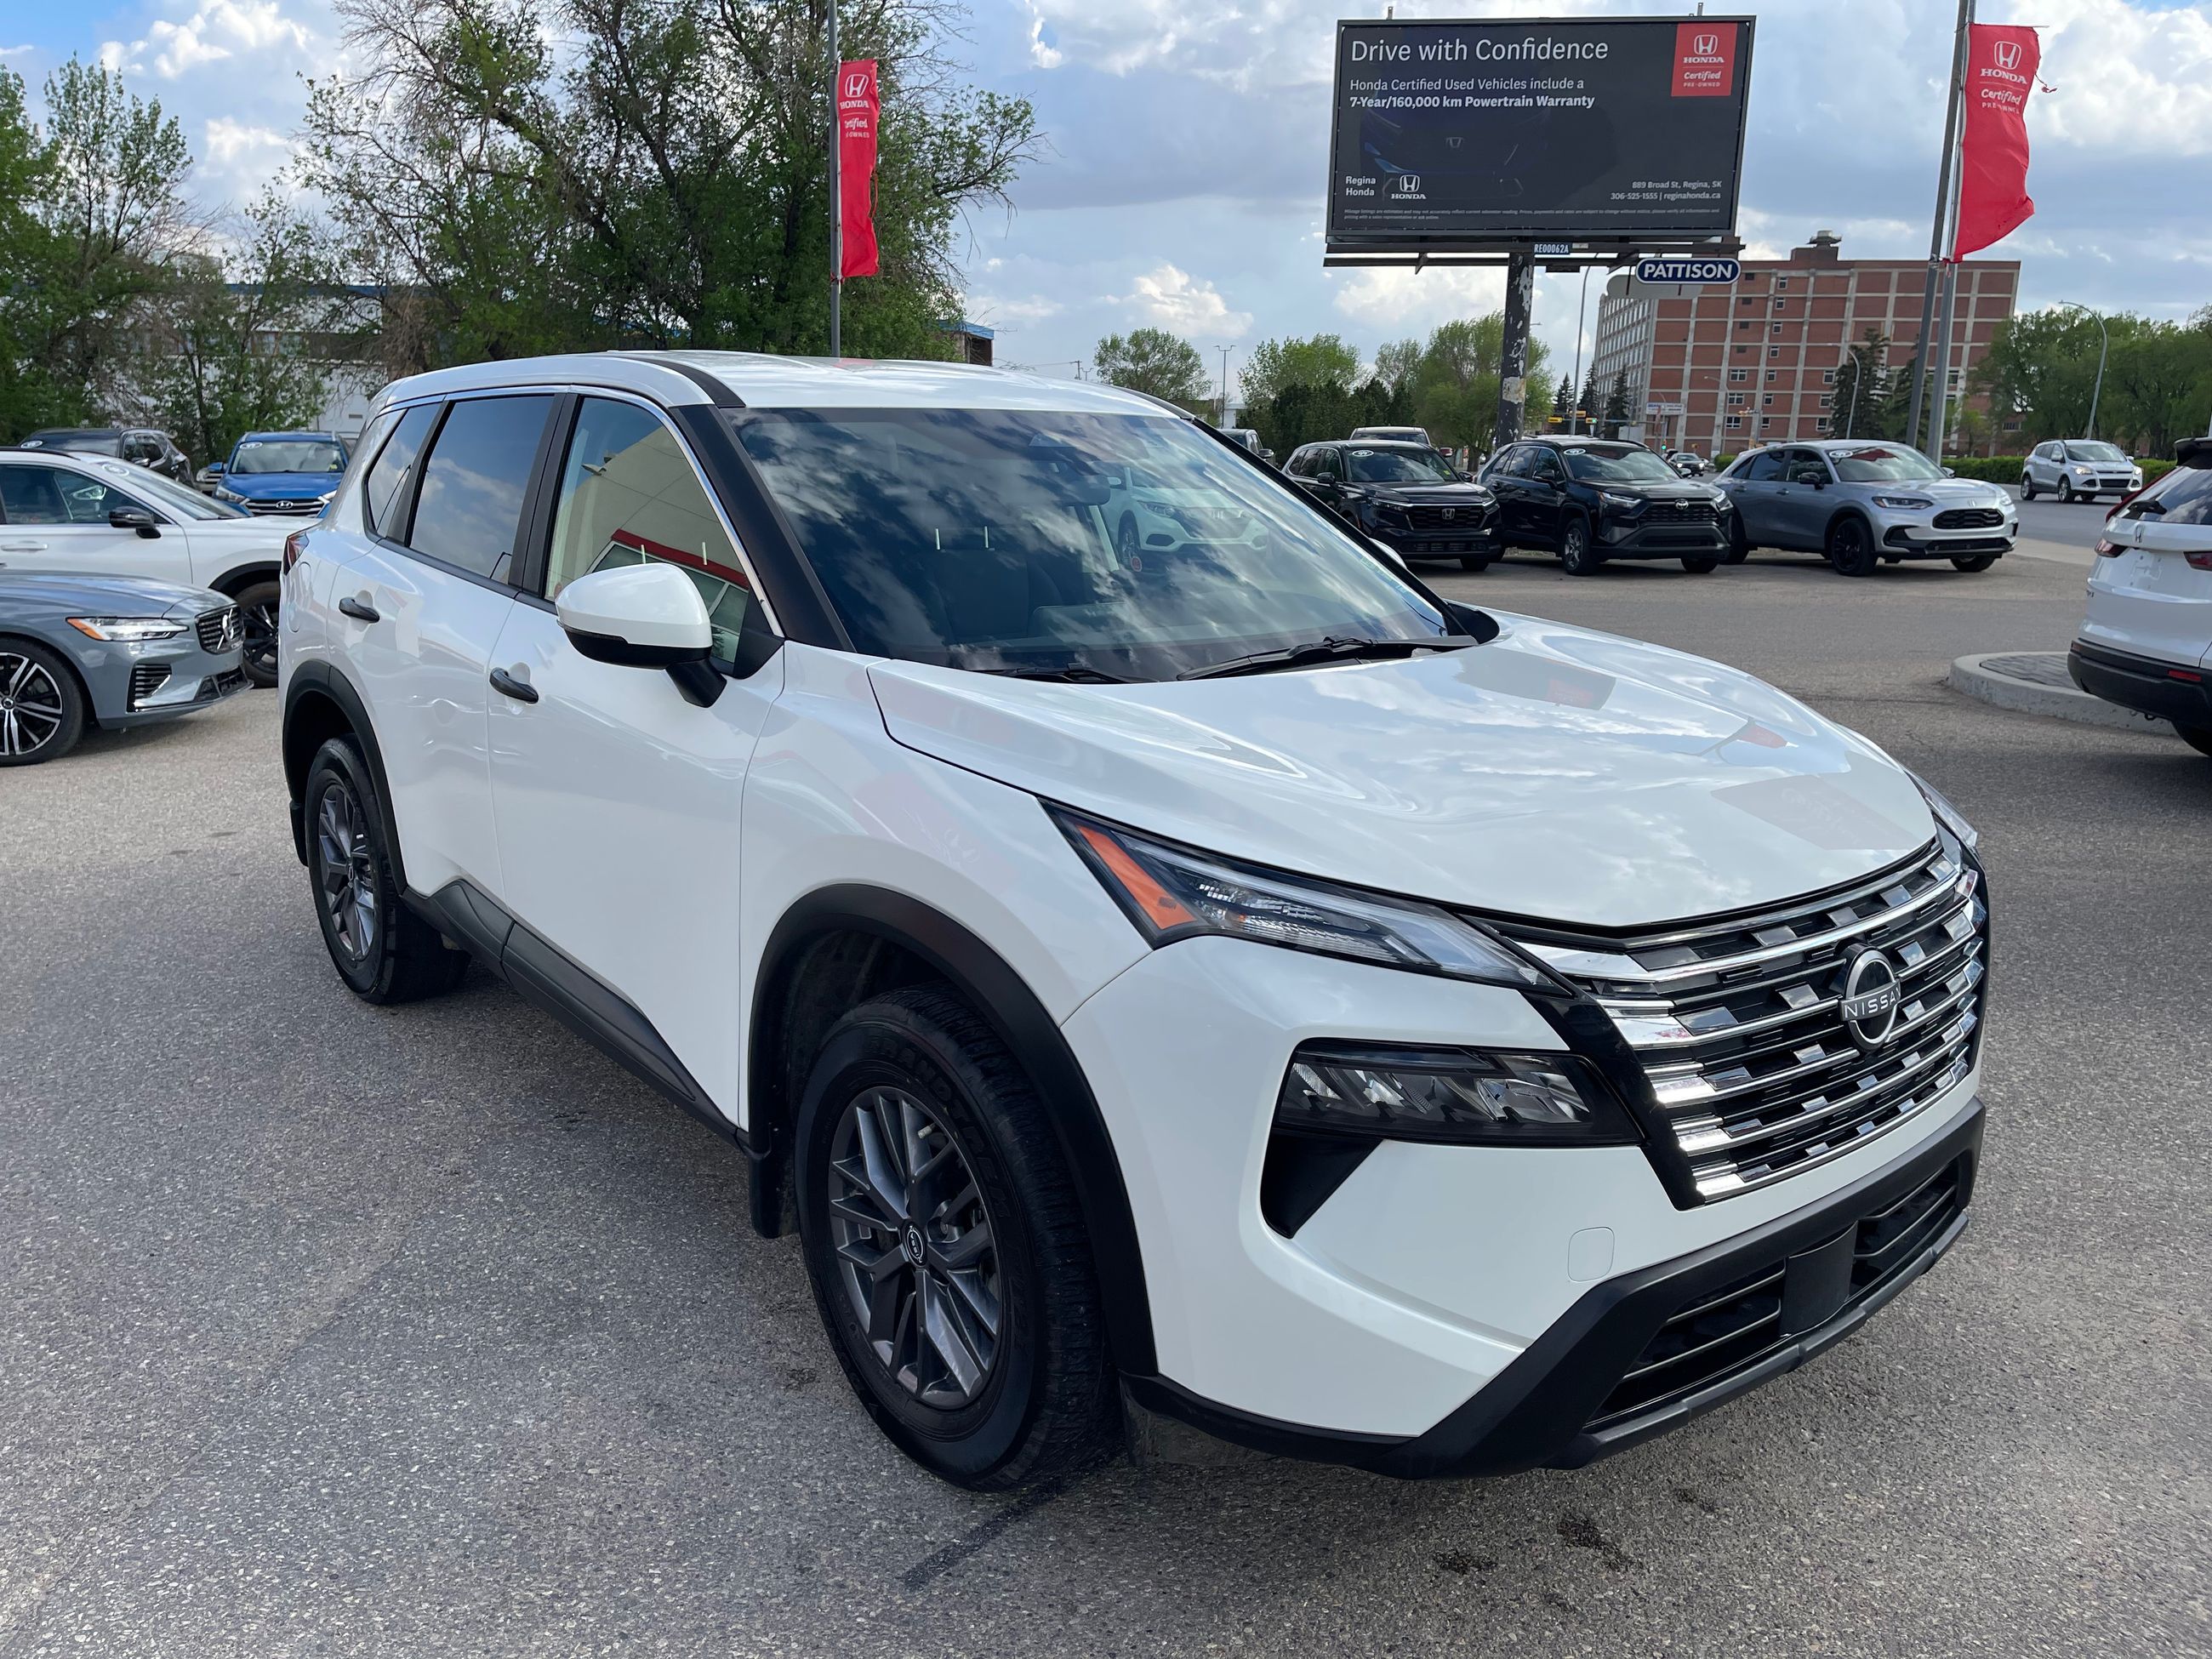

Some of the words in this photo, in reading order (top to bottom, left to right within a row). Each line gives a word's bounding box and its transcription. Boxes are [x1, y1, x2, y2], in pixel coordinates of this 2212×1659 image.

[1351, 39, 1411, 61] Drive
[1418, 38, 1468, 60] with
[1475, 37, 1608, 60] Confidence
[1684, 71, 1721, 81] Certified
[1980, 68, 2027, 84] HONDA
[1350, 80, 1388, 90] Honda
[1391, 78, 1441, 90] Certified
[1445, 78, 1474, 90] Used
[1478, 77, 1526, 89] Vehicles
[1531, 77, 1574, 89] include
[1576, 81, 1584, 89] a
[1349, 96, 1440, 109] 7-Year/160,000
[1443, 96, 1462, 107] km
[1465, 96, 1533, 108] Powertrain
[1536, 95, 1594, 109] Warranty
[1981, 88, 2022, 105] Certified
[840, 100, 869, 110] HONDA
[1345, 175, 1376, 185] Regina
[1683, 180, 1710, 190] Regina,
[1346, 187, 1375, 196] Honda
[1663, 191, 1720, 201] reginahonda.ca
[1534, 243, 1569, 254] RE00062A
[1644, 263, 1732, 278] PATTISON
